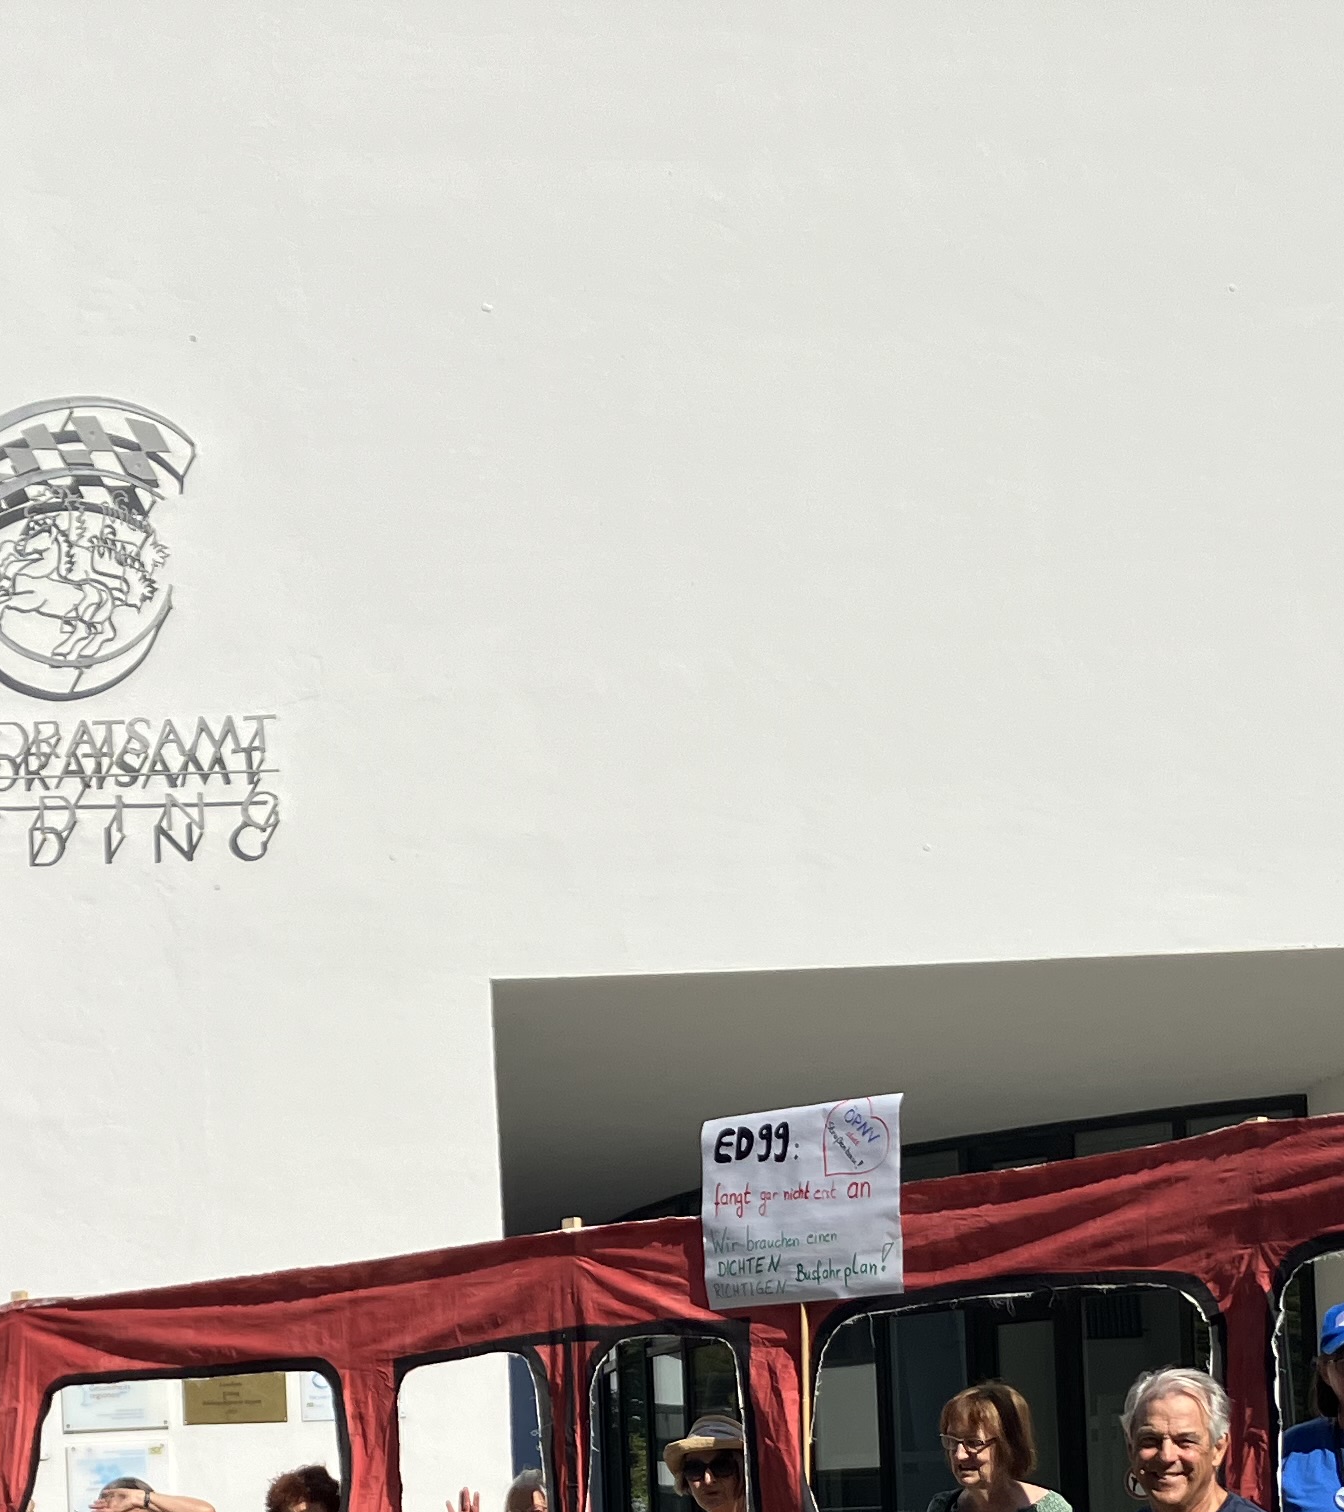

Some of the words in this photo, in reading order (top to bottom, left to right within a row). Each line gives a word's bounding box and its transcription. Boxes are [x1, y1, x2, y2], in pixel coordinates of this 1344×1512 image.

[759, 1190, 779, 1217] gar
[783, 1180, 810, 1201] nicht
[812, 1181, 838, 1201] erst
[846, 1180, 871, 1200] an
[710, 1226, 744, 1254] Wir
[746, 1225, 800, 1252] brauchen
[806, 1232, 838, 1245] einen
[717, 1253, 782, 1278] DICHTEN
[713, 1279, 788, 1299] RICHTIGEN
